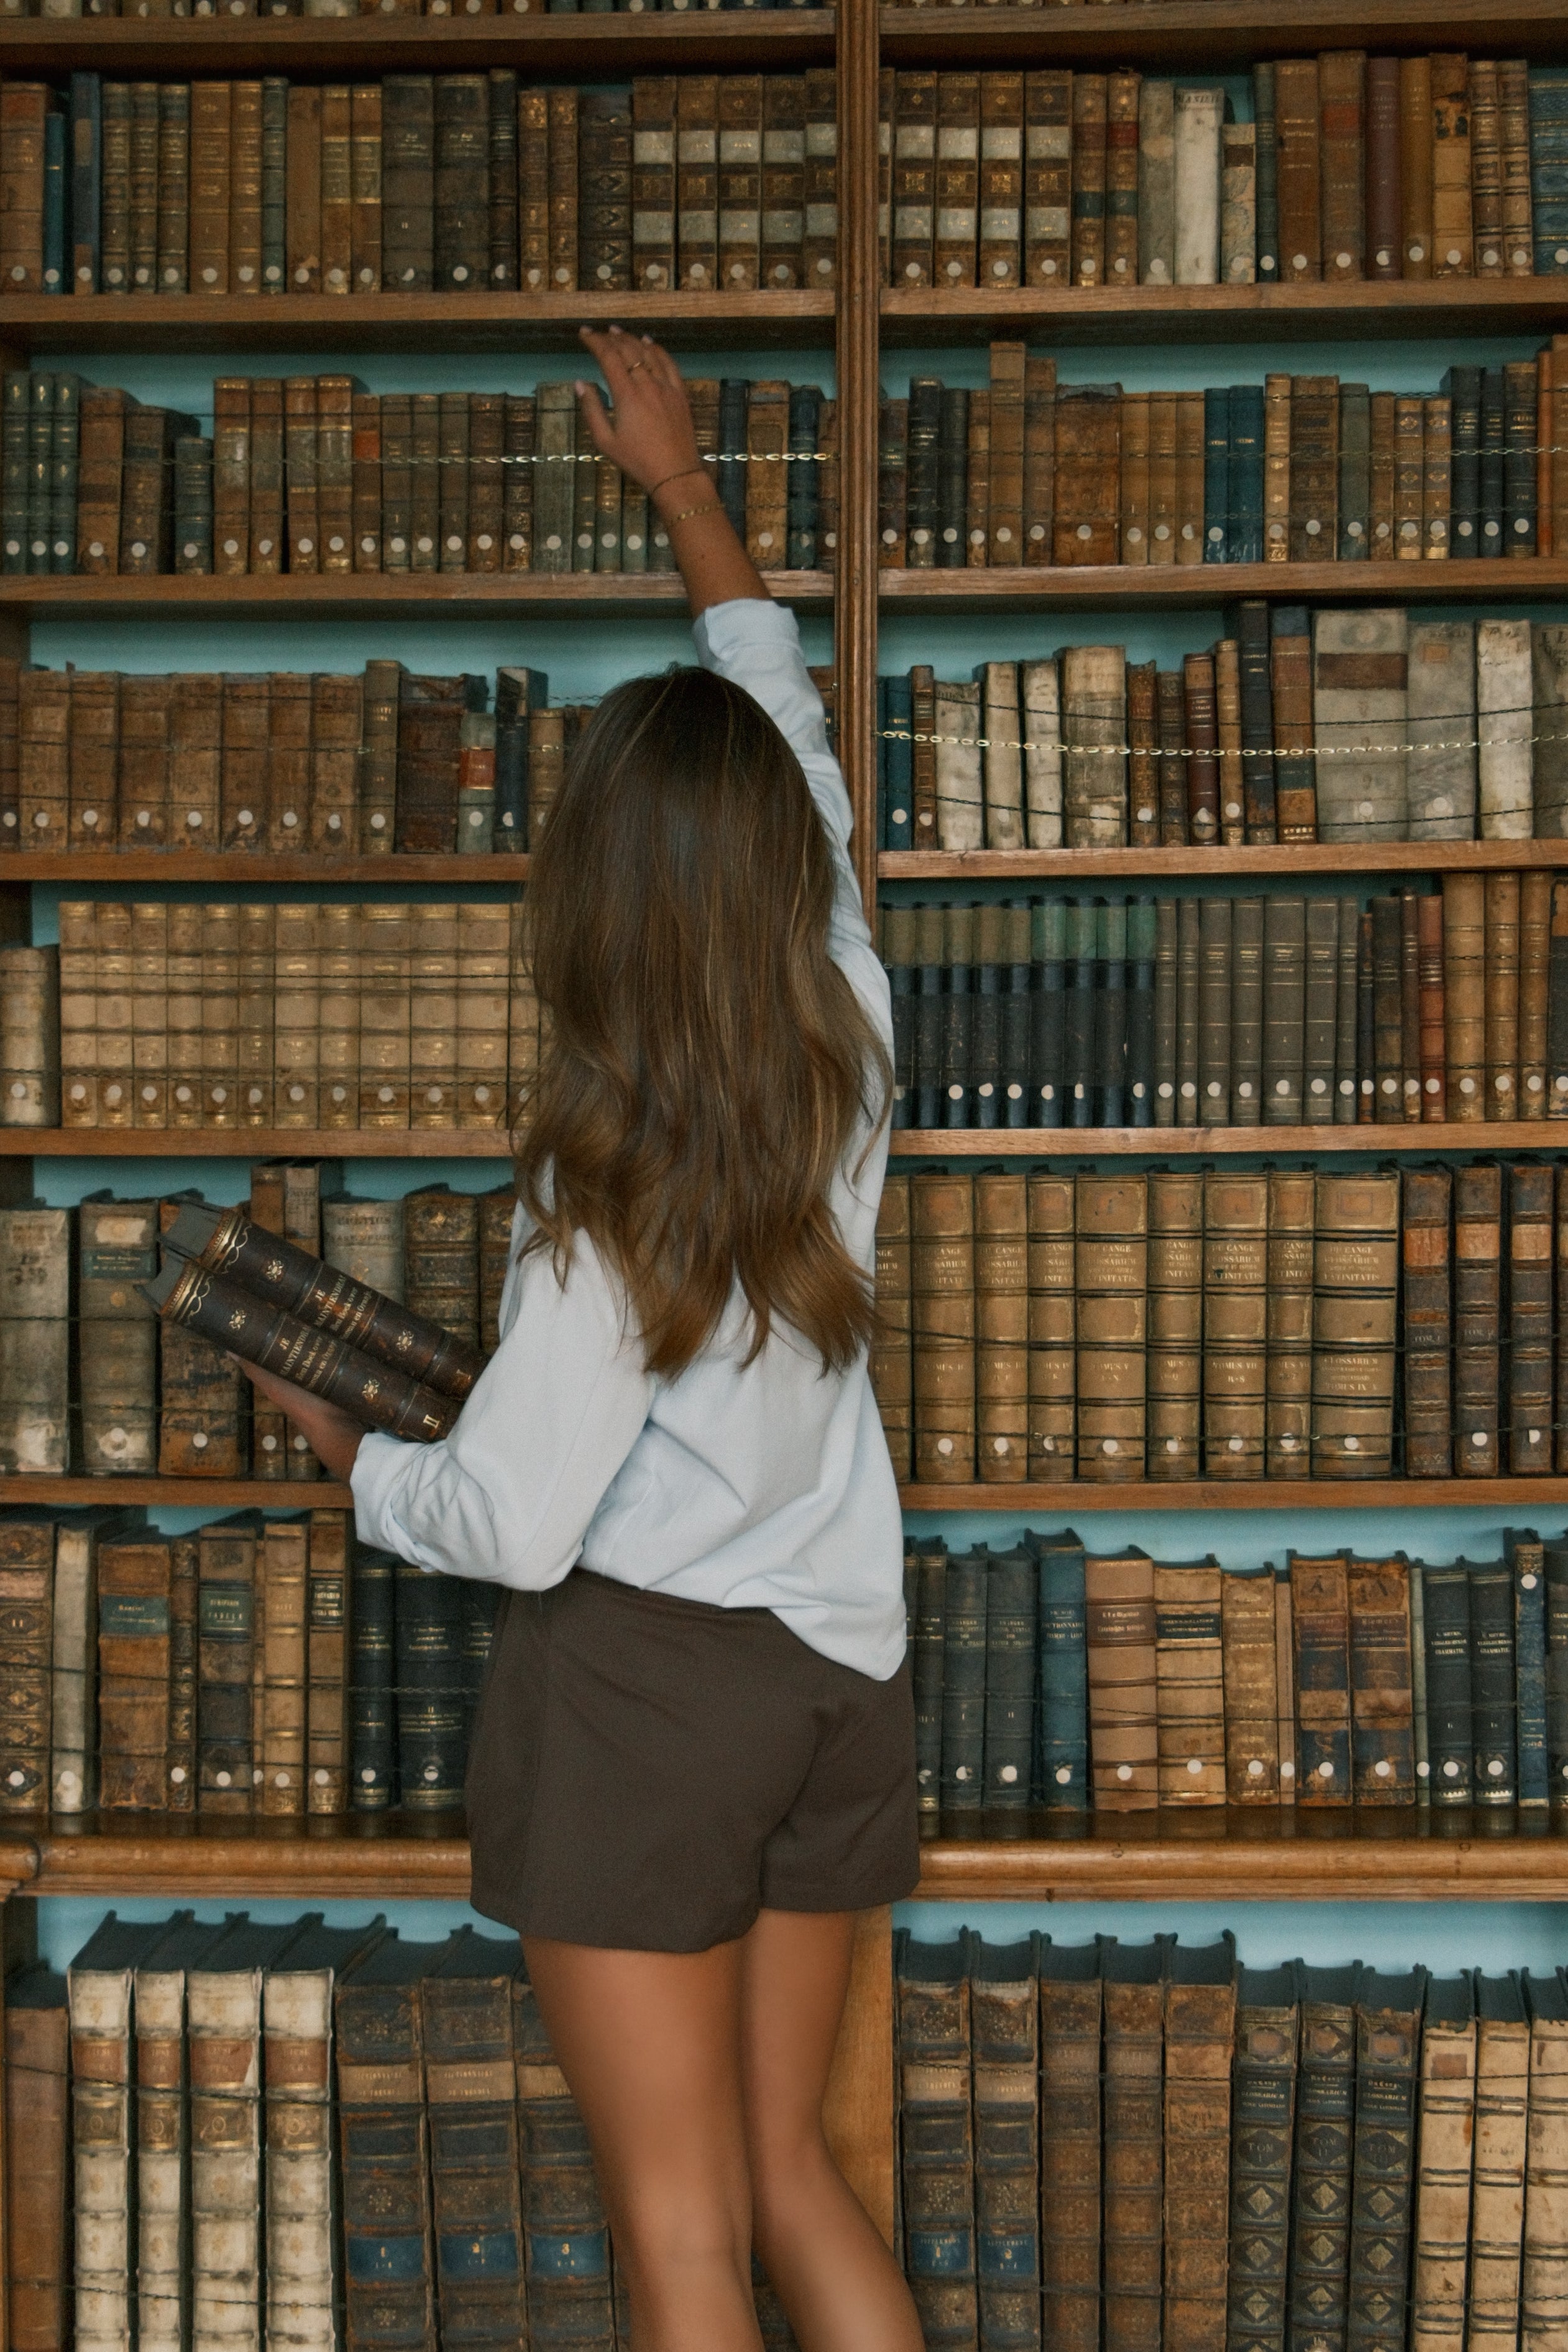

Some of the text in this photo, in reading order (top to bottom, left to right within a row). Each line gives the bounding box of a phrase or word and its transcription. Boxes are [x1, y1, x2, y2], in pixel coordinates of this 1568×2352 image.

[315, 1289, 326, 1302] JE
[340, 1320, 357, 1341] assau
[354, 1311, 362, 1321] en
[279, 1338, 290, 1351] JE
[306, 1369, 323, 1389] assau
[423, 1414, 441, 1429] II
[1249, 2142, 1275, 2152] TOM
